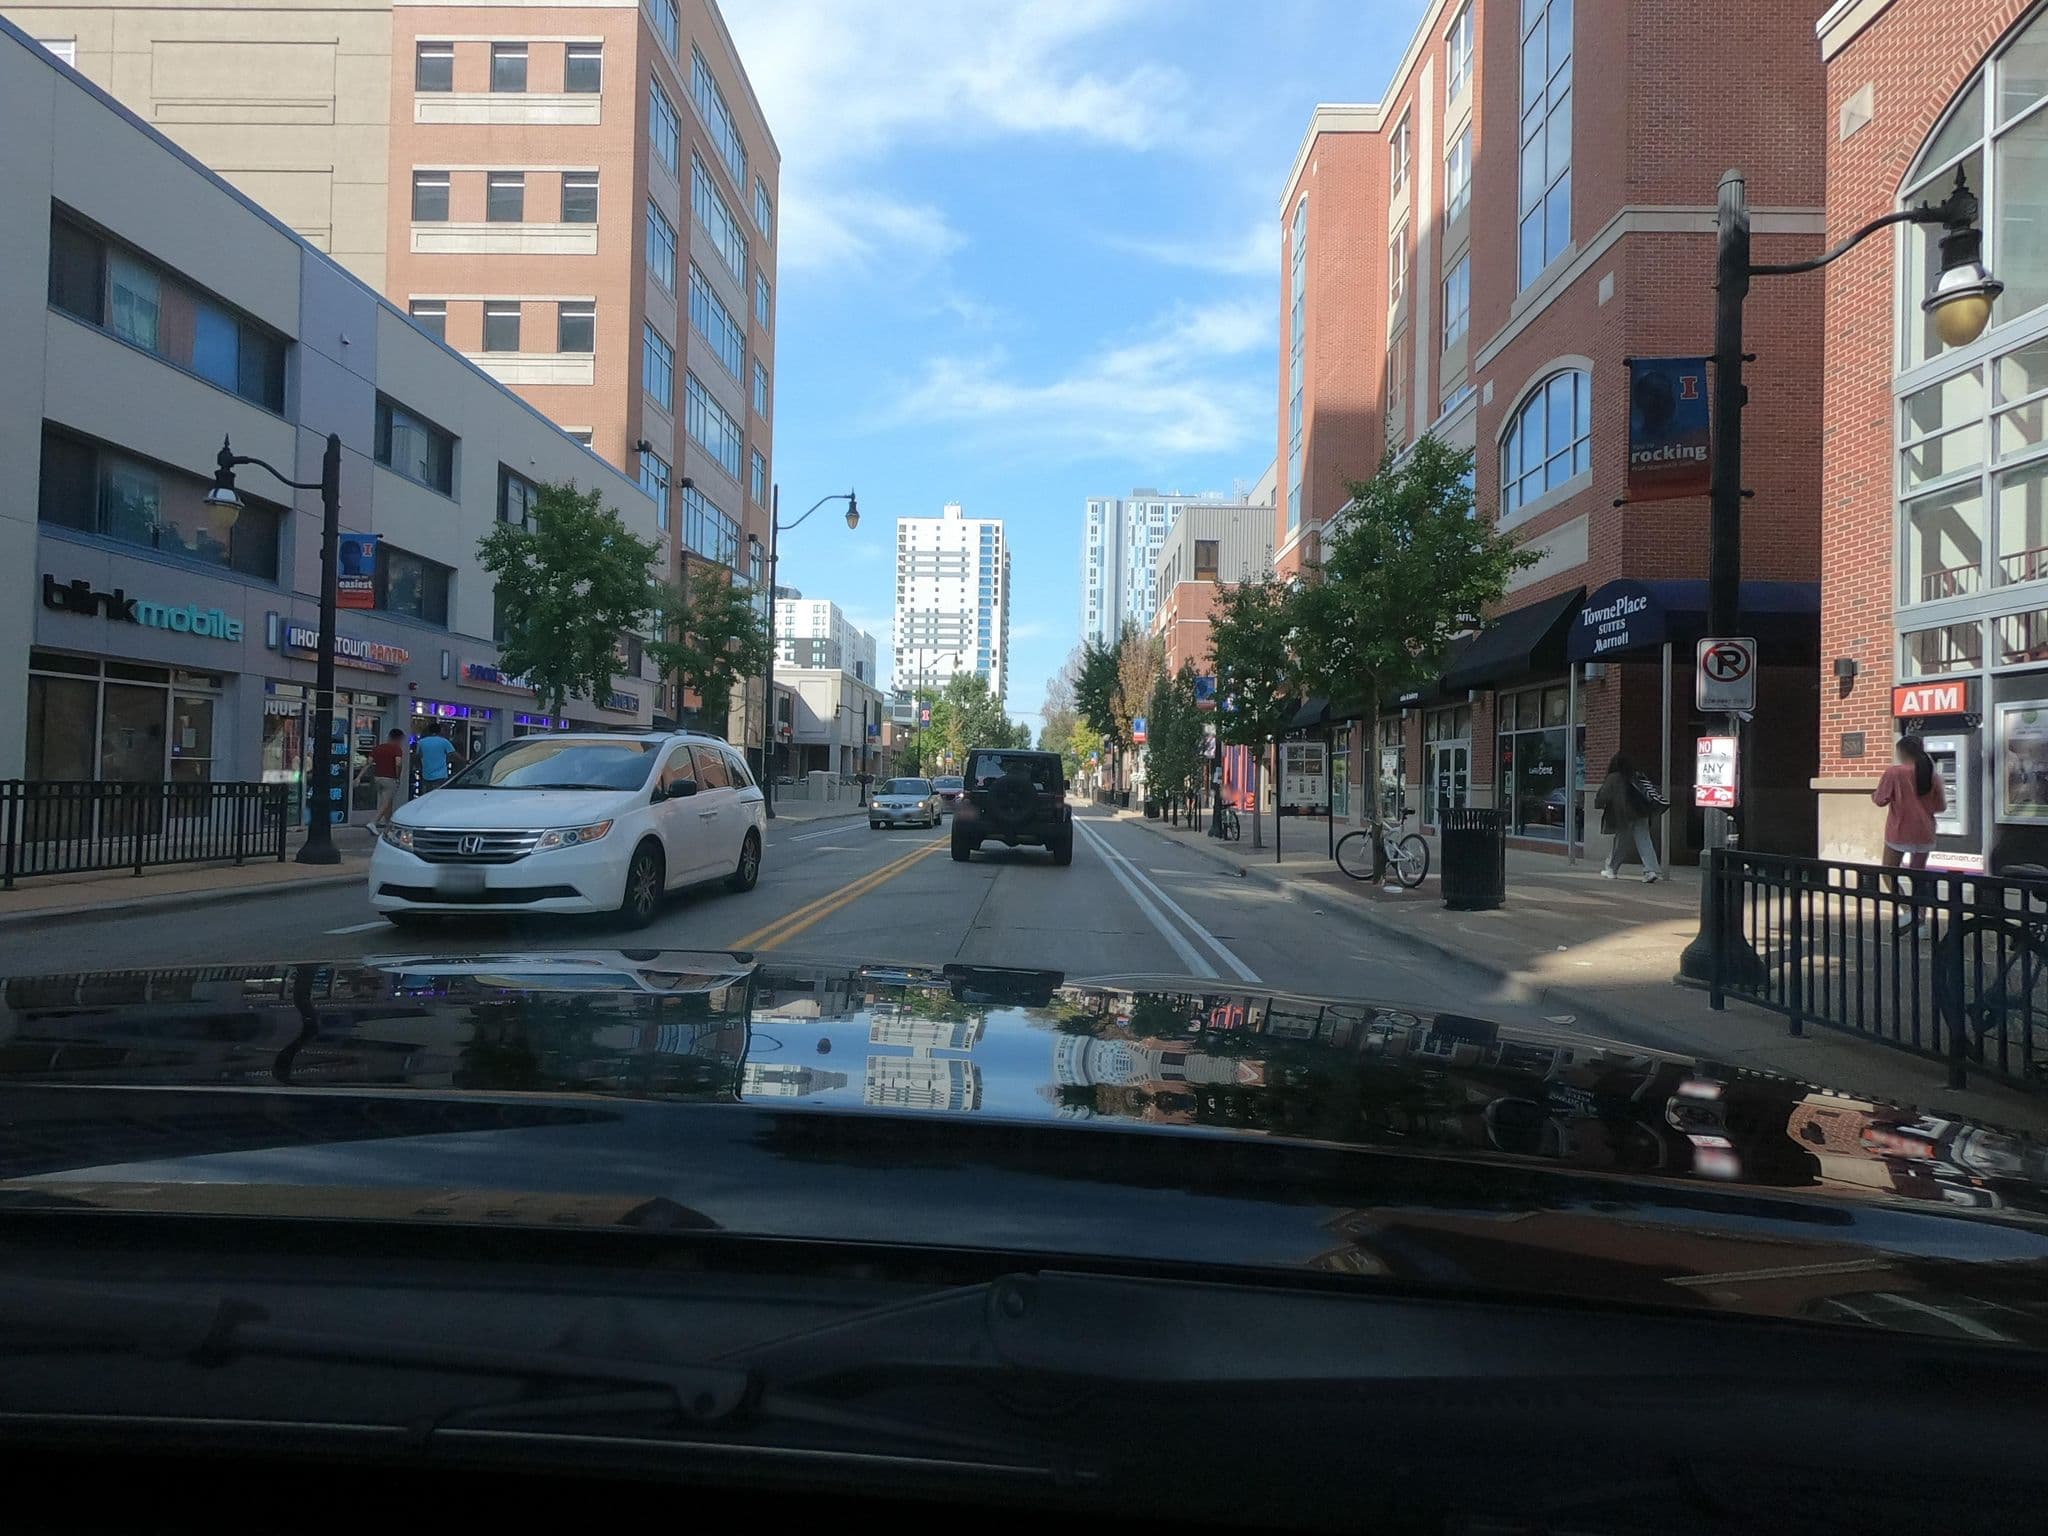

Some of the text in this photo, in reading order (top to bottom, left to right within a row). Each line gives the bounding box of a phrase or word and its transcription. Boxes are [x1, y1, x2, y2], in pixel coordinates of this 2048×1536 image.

[1631, 443, 1708, 464] rocking
[338, 579, 373, 589] easiest
[1581, 595, 1648, 626] TownePlace
[1598, 618, 1626, 635] SUITES
[297, 629, 369, 658] HOTOWN
[1901, 687, 1958, 713] ATM
[1698, 741, 1711, 754] NO
[1702, 762, 1725, 774] ANY
